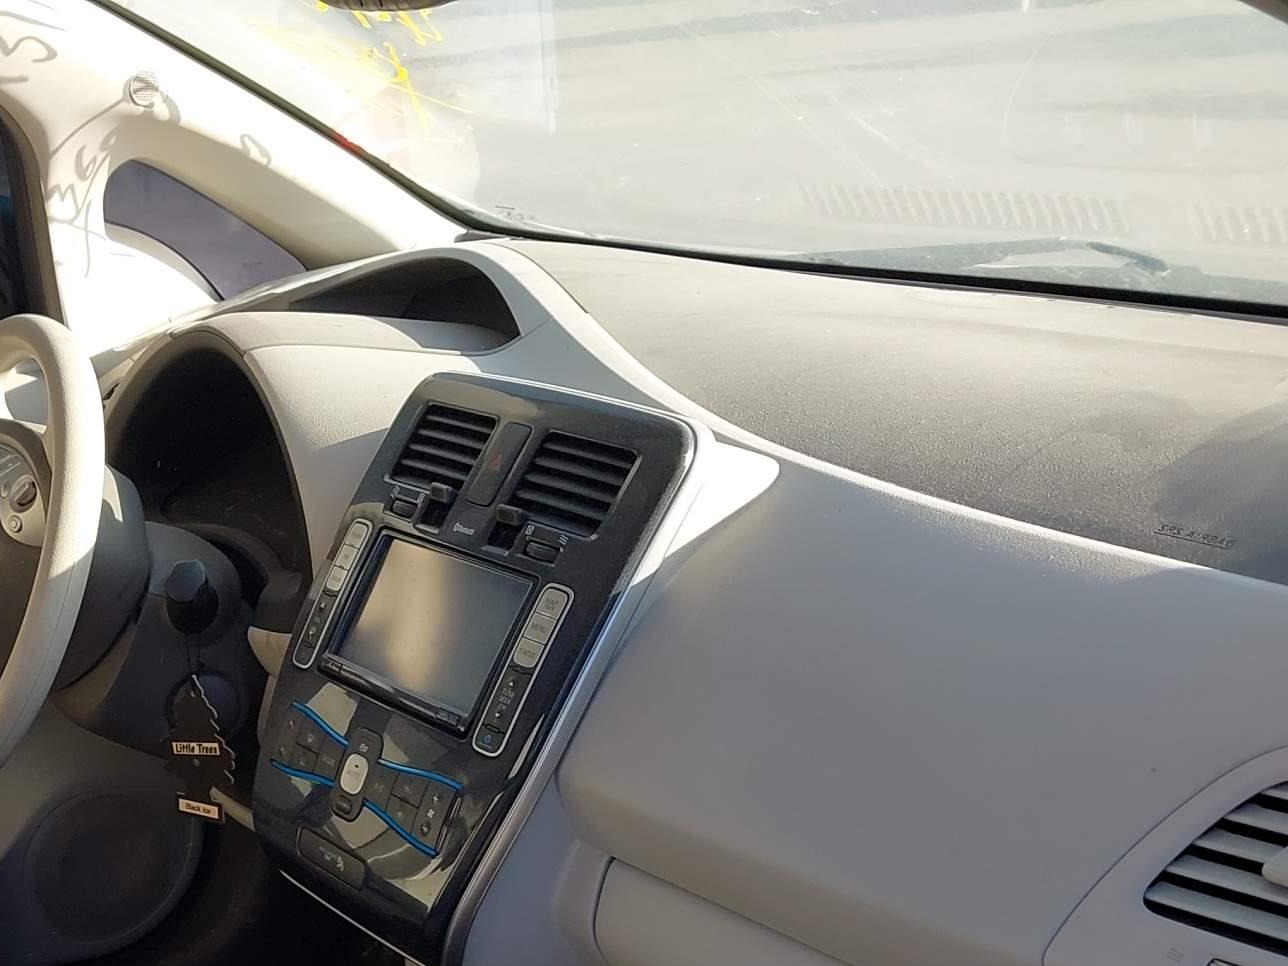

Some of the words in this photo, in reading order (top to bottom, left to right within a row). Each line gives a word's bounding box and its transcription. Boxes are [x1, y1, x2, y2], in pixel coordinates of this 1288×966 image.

[1186, 531, 1238, 548] AIRBAG
[175, 743, 195, 753] Little
[196, 743, 218, 754] Trees
